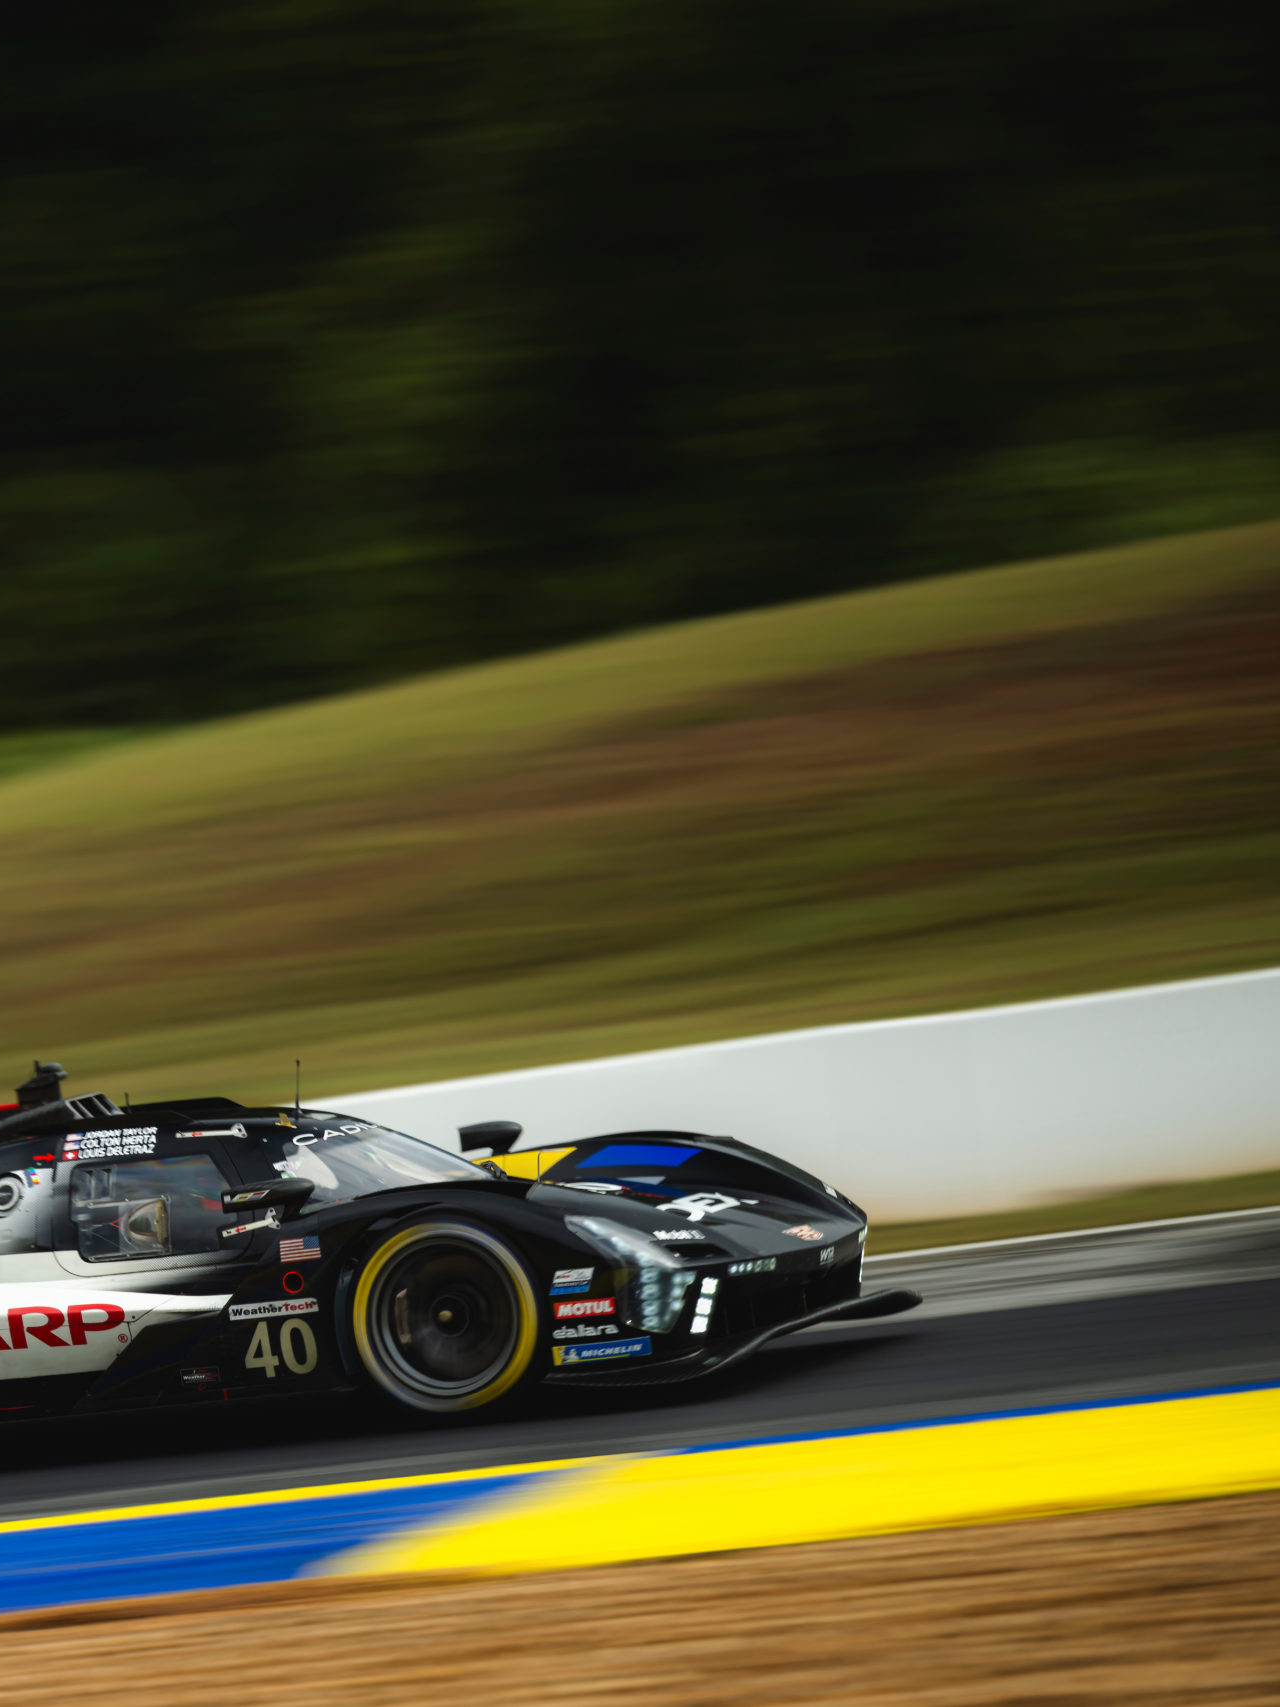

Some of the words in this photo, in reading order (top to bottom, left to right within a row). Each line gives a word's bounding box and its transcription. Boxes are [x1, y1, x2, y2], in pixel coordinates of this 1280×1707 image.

[82, 1129, 121, 1140] JORDAN
[122, 1126, 158, 1136] TAYLOR
[292, 1123, 378, 1146] CADIL
[80, 1137, 121, 1149] COLTON
[122, 1135, 157, 1146] HERTA
[78, 1148, 106, 1159] LOUIS
[106, 1144, 155, 1156] DELETRAZ
[232, 1301, 314, 1317] WeatherTech
[557, 1300, 613, 1317] MOTUL
[552, 1324, 619, 1339] dallara
[244, 1318, 318, 1378] 40
[581, 1343, 643, 1358] MICHELIN
